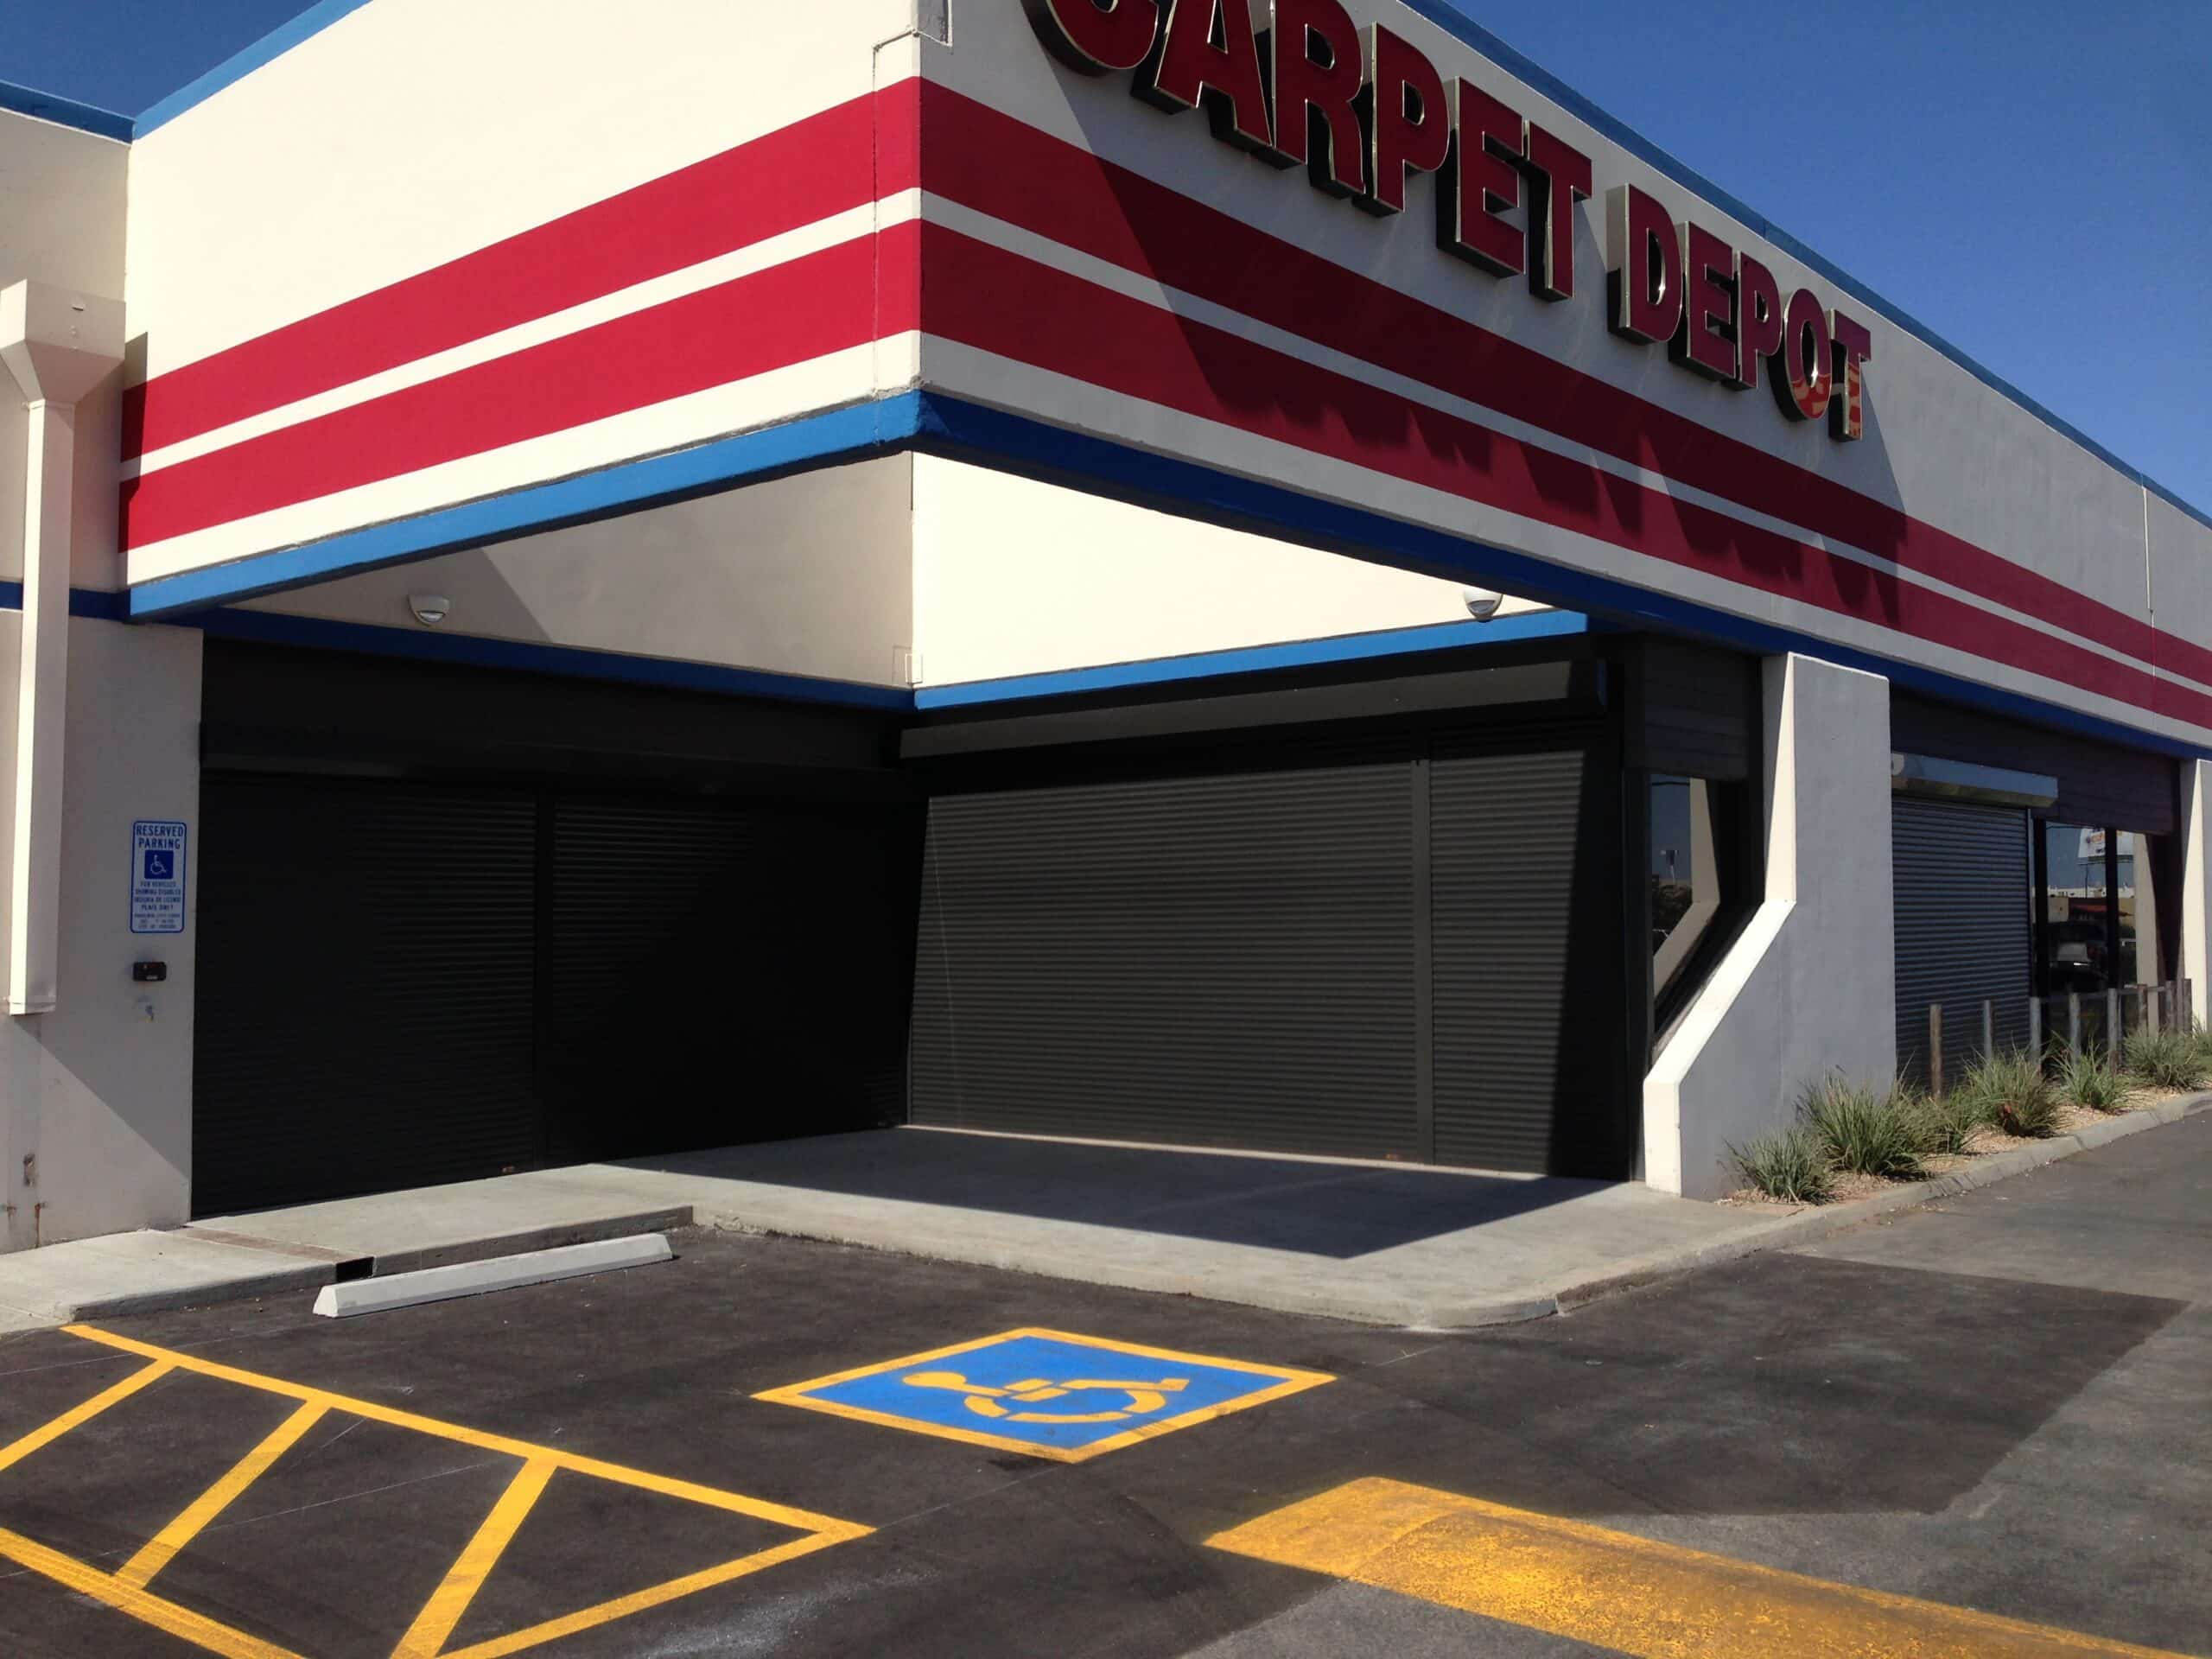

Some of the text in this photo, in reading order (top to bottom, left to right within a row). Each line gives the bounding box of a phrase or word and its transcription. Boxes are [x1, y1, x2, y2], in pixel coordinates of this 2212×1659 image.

[1609, 182, 1872, 442] DEPOT
[137, 825, 184, 837] RESERVED
[138, 837, 181, 849] PARKING
